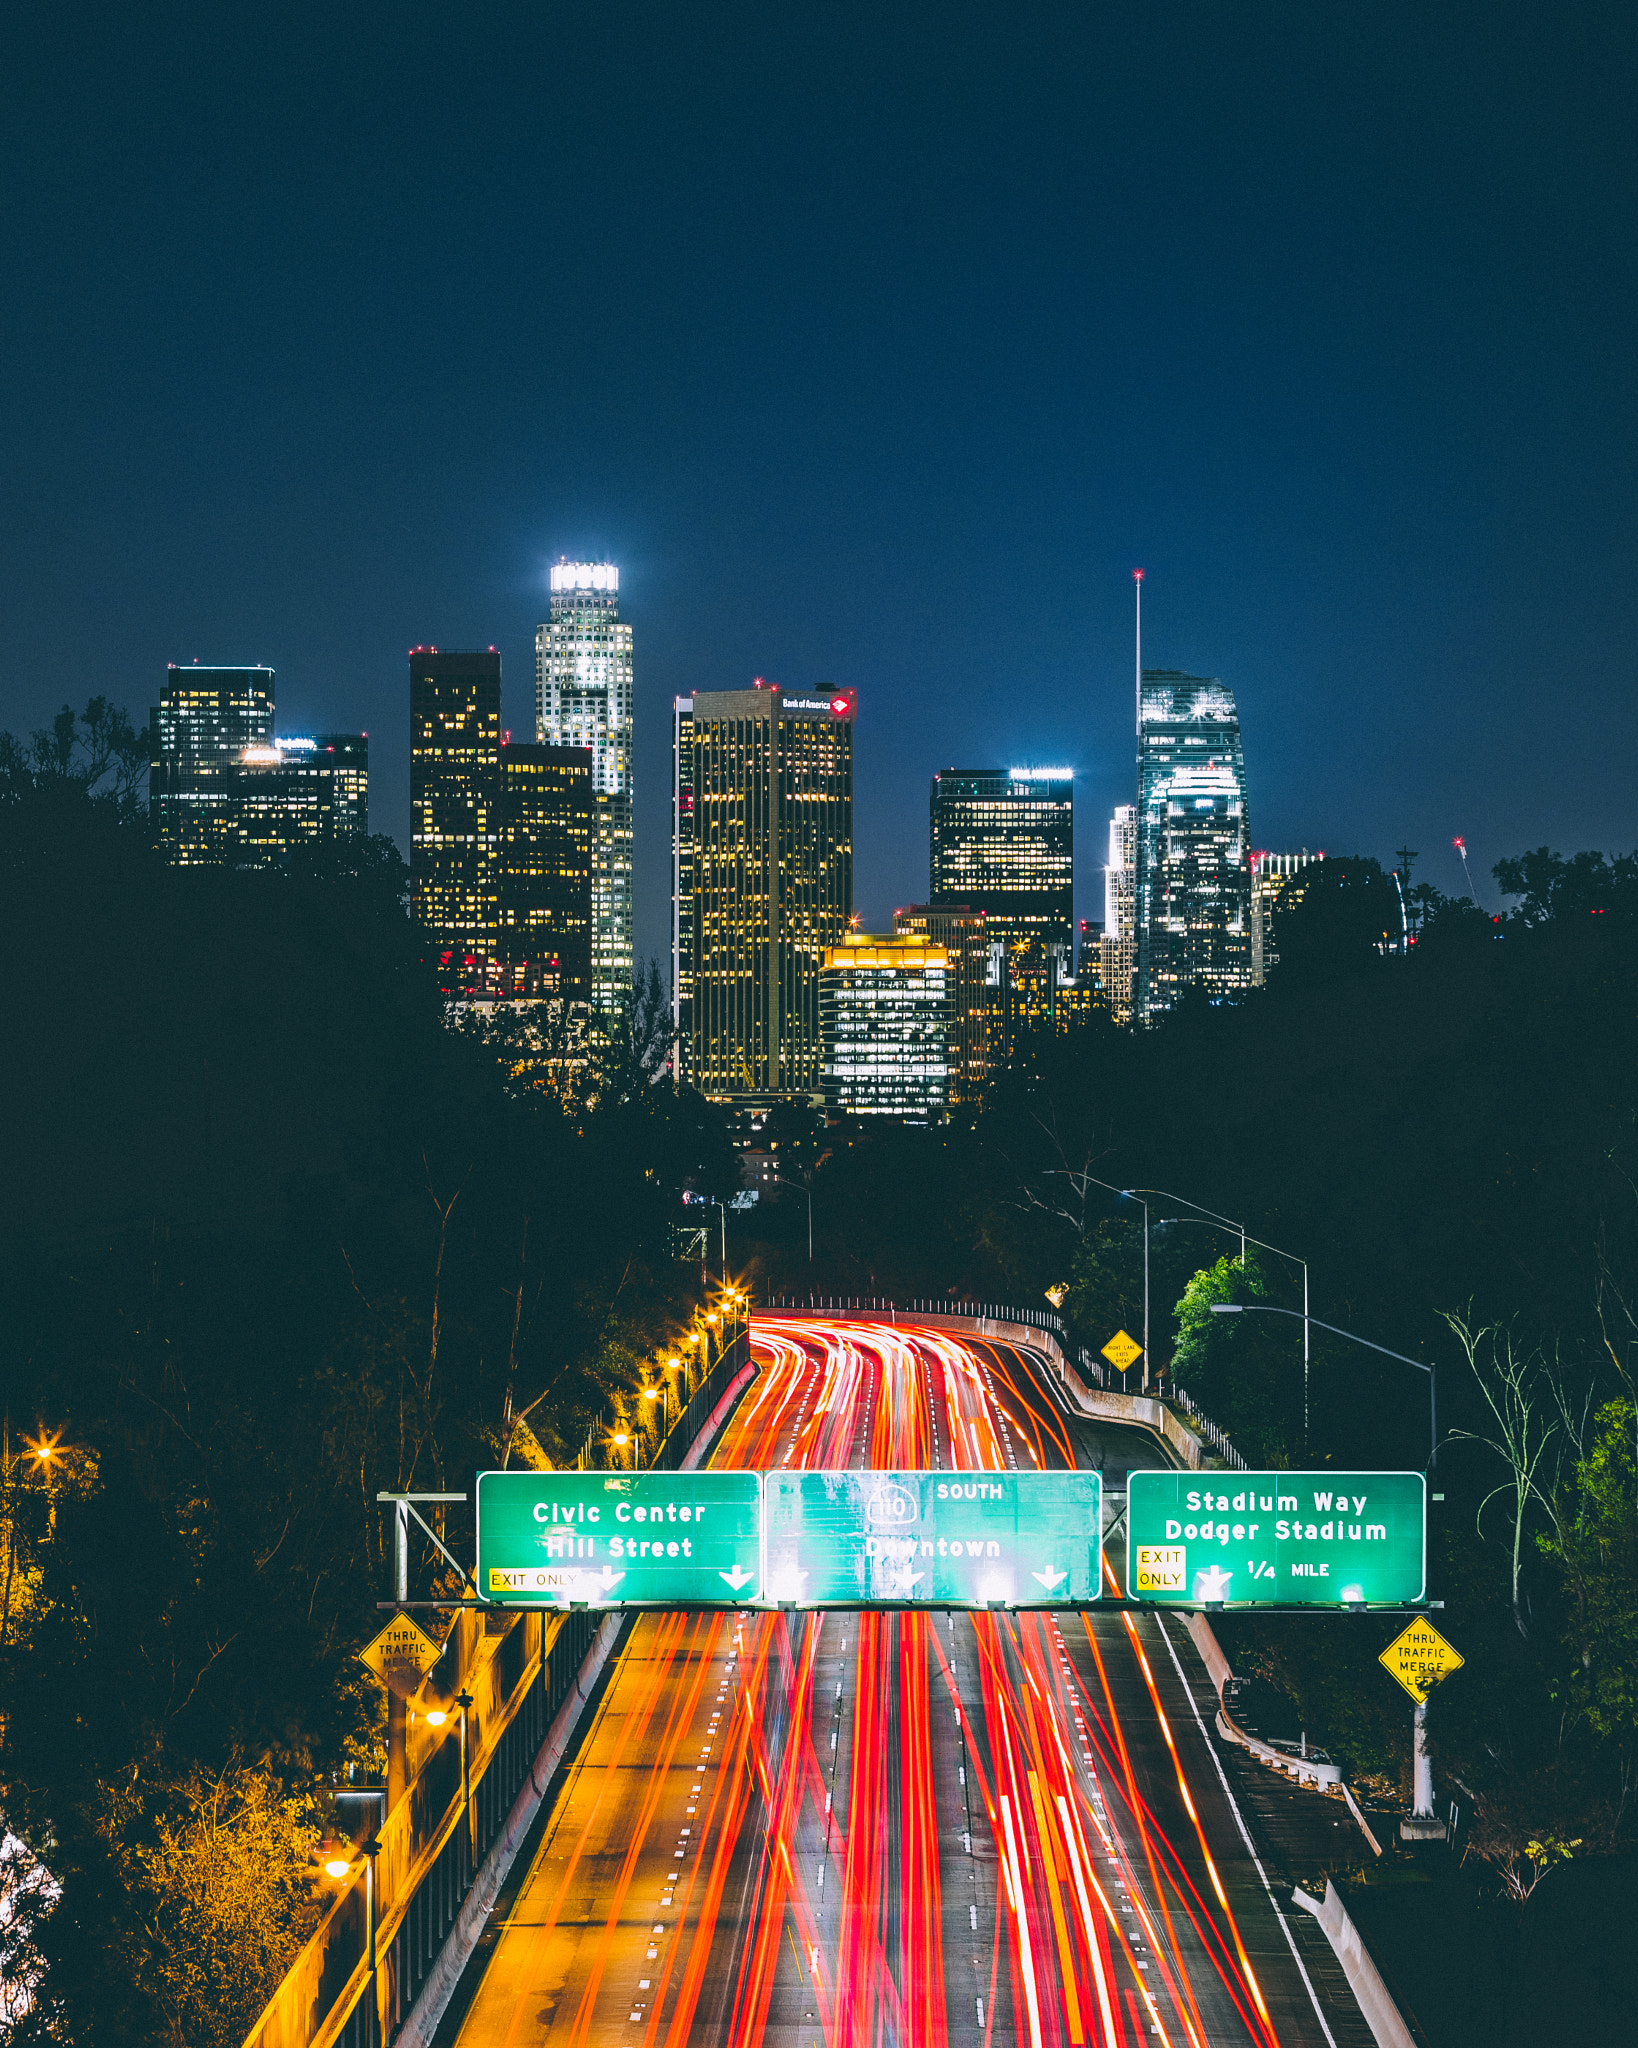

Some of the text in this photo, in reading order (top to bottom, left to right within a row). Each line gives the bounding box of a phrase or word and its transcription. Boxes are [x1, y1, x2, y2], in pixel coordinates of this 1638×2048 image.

[783, 698, 831, 709] Bank of America
[936, 1483, 1003, 1500] SOUTH
[1186, 1491, 1367, 1516] Stadium Way
[532, 1502, 706, 1523] Civic Center
[1165, 1520, 1387, 1546] Dodger Stadium
[546, 1536, 693, 1558] Hill Street
[865, 1536, 1001, 1558] Downtown
[1140, 1551, 1181, 1563] EXIT
[1291, 1563, 1330, 1577] MILE
[491, 1574, 578, 1586] EXIT ONLY
[1140, 1573, 1181, 1585] ONLY
[386, 1631, 417, 1641] THRU
[1407, 1634, 1436, 1644] THRU
[379, 1643, 426, 1654] TRAFFIC
[1398, 1647, 1445, 1658] TRAFFIC
[384, 1656, 420, 1667] MEGE
[1400, 1662, 1444, 1672] MERGE
